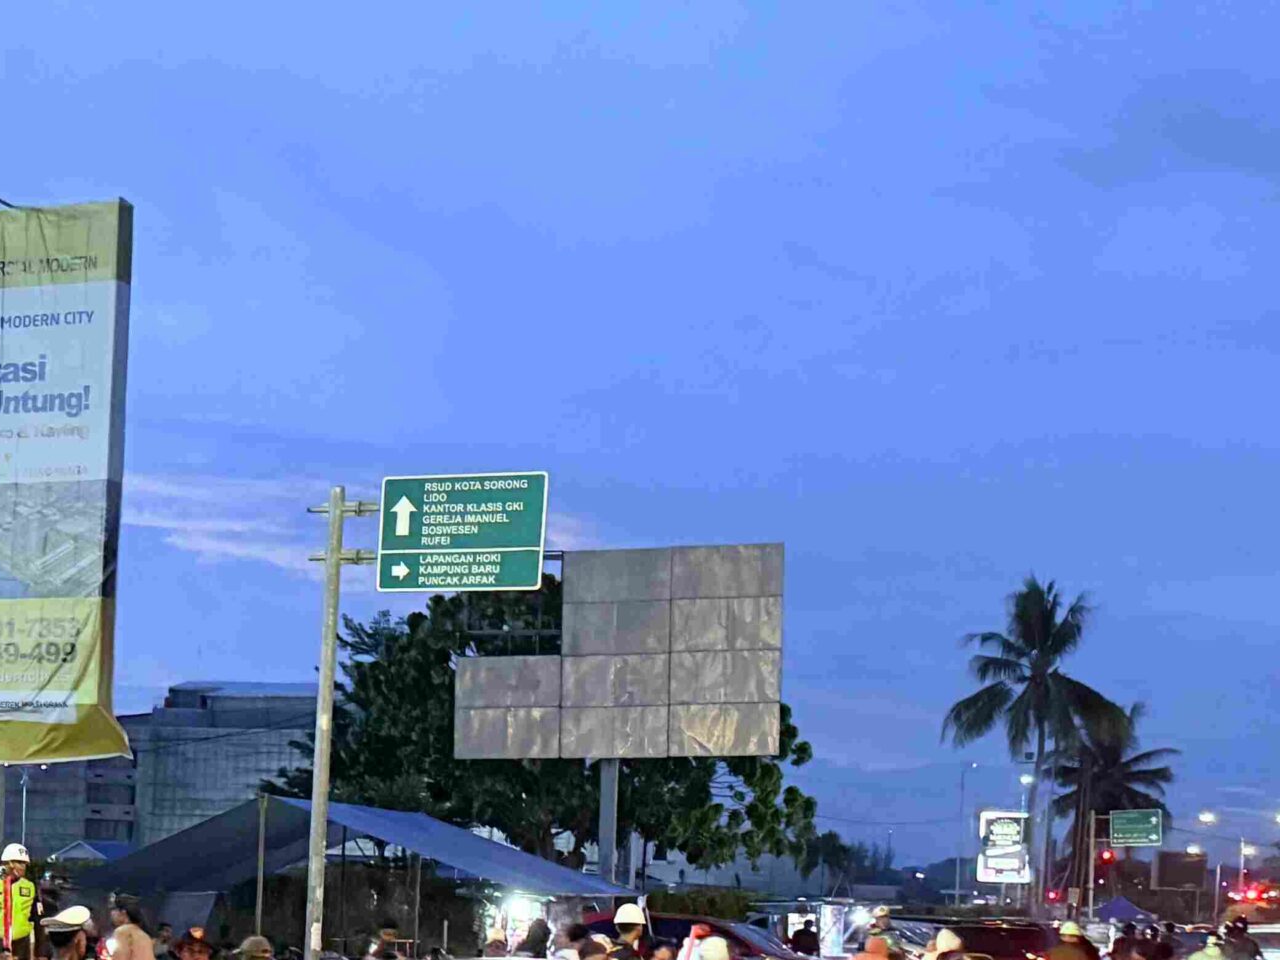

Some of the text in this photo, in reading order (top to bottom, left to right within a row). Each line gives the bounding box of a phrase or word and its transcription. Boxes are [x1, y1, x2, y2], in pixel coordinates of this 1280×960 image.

[0, 313, 60, 330] MODERN
[64, 311, 95, 325] CITY
[425, 480, 528, 491] RSUD KOTA SORONG
[424, 493, 447, 502] LIDO
[423, 502, 523, 513] KANTOR KLASIS GKI
[422, 513, 509, 524] GEREJA IMANUEL
[422, 525, 478, 535] BOSWESEN
[421, 536, 450, 545] RUFEI
[420, 553, 501, 564] LAPANGAN HOKI
[419, 564, 500, 574] KAMPUNG BARU
[418, 575, 495, 585] PUNCAK ARFAK
